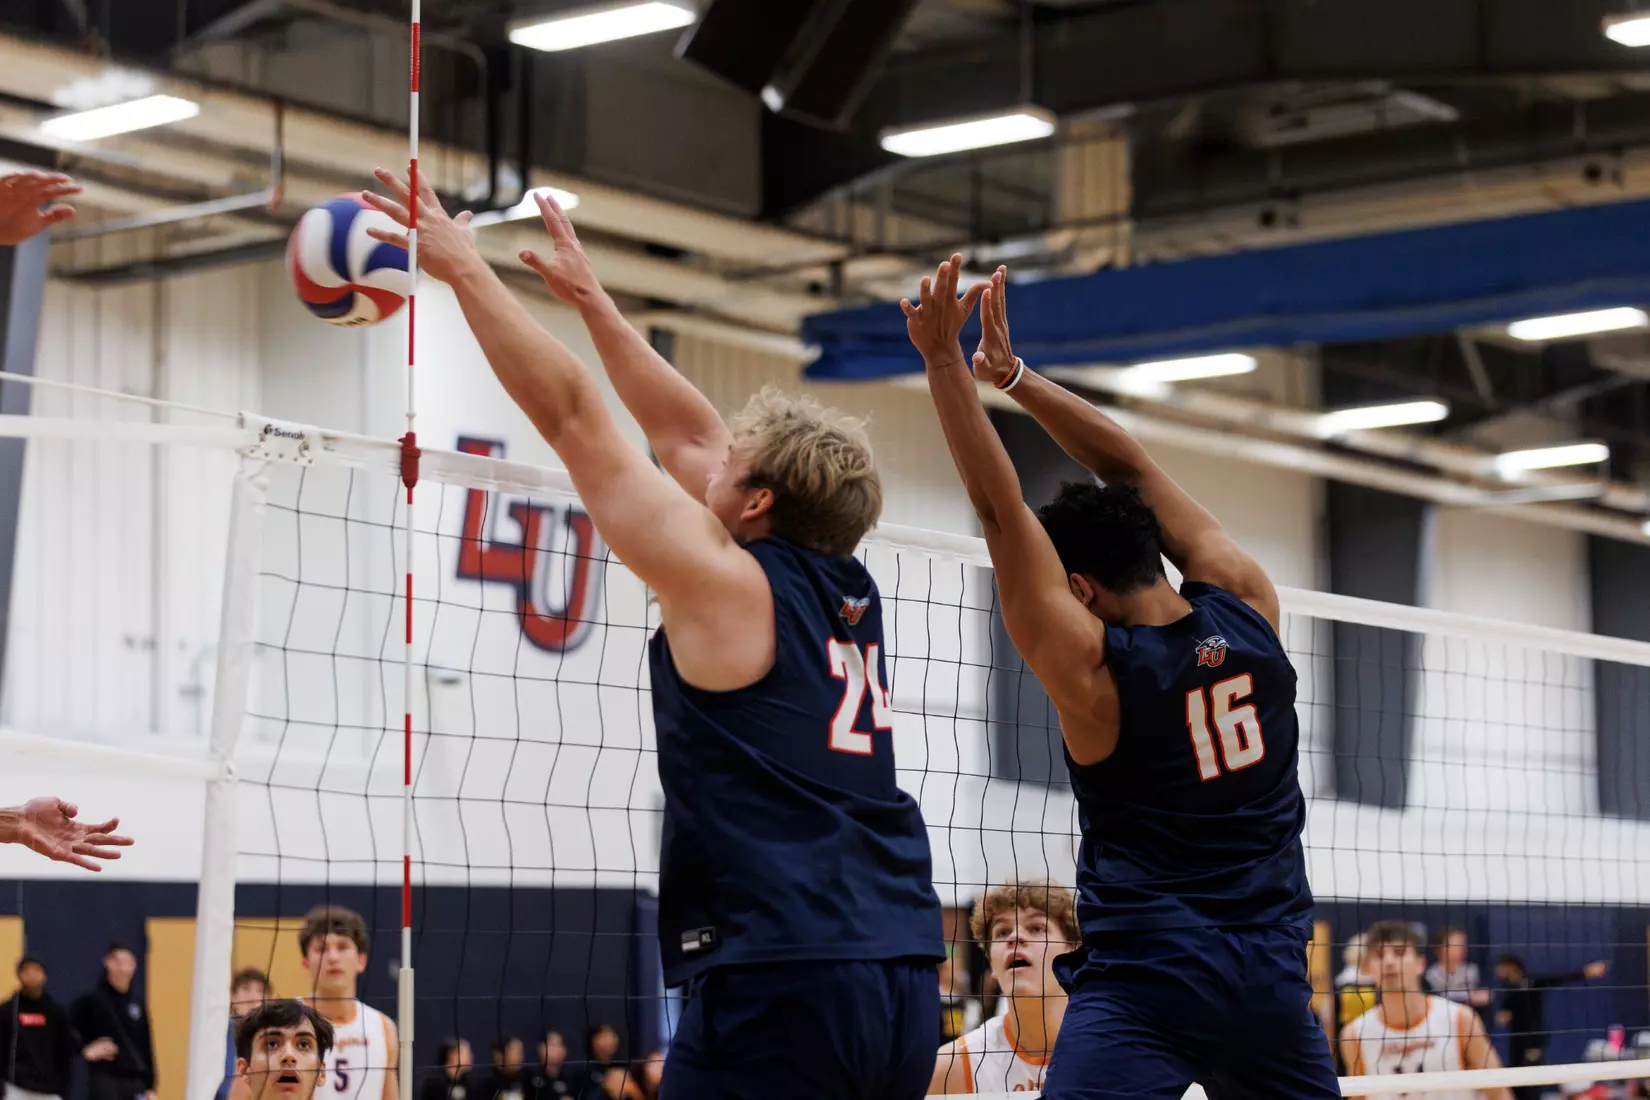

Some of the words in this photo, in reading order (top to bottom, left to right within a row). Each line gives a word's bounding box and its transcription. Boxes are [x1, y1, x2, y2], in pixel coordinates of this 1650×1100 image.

[456, 436, 607, 655] LU
[827, 637, 893, 756] 24
[1197, 646, 1227, 667] LU
[1184, 672, 1266, 782] 16
[334, 1058, 349, 1092] 5
